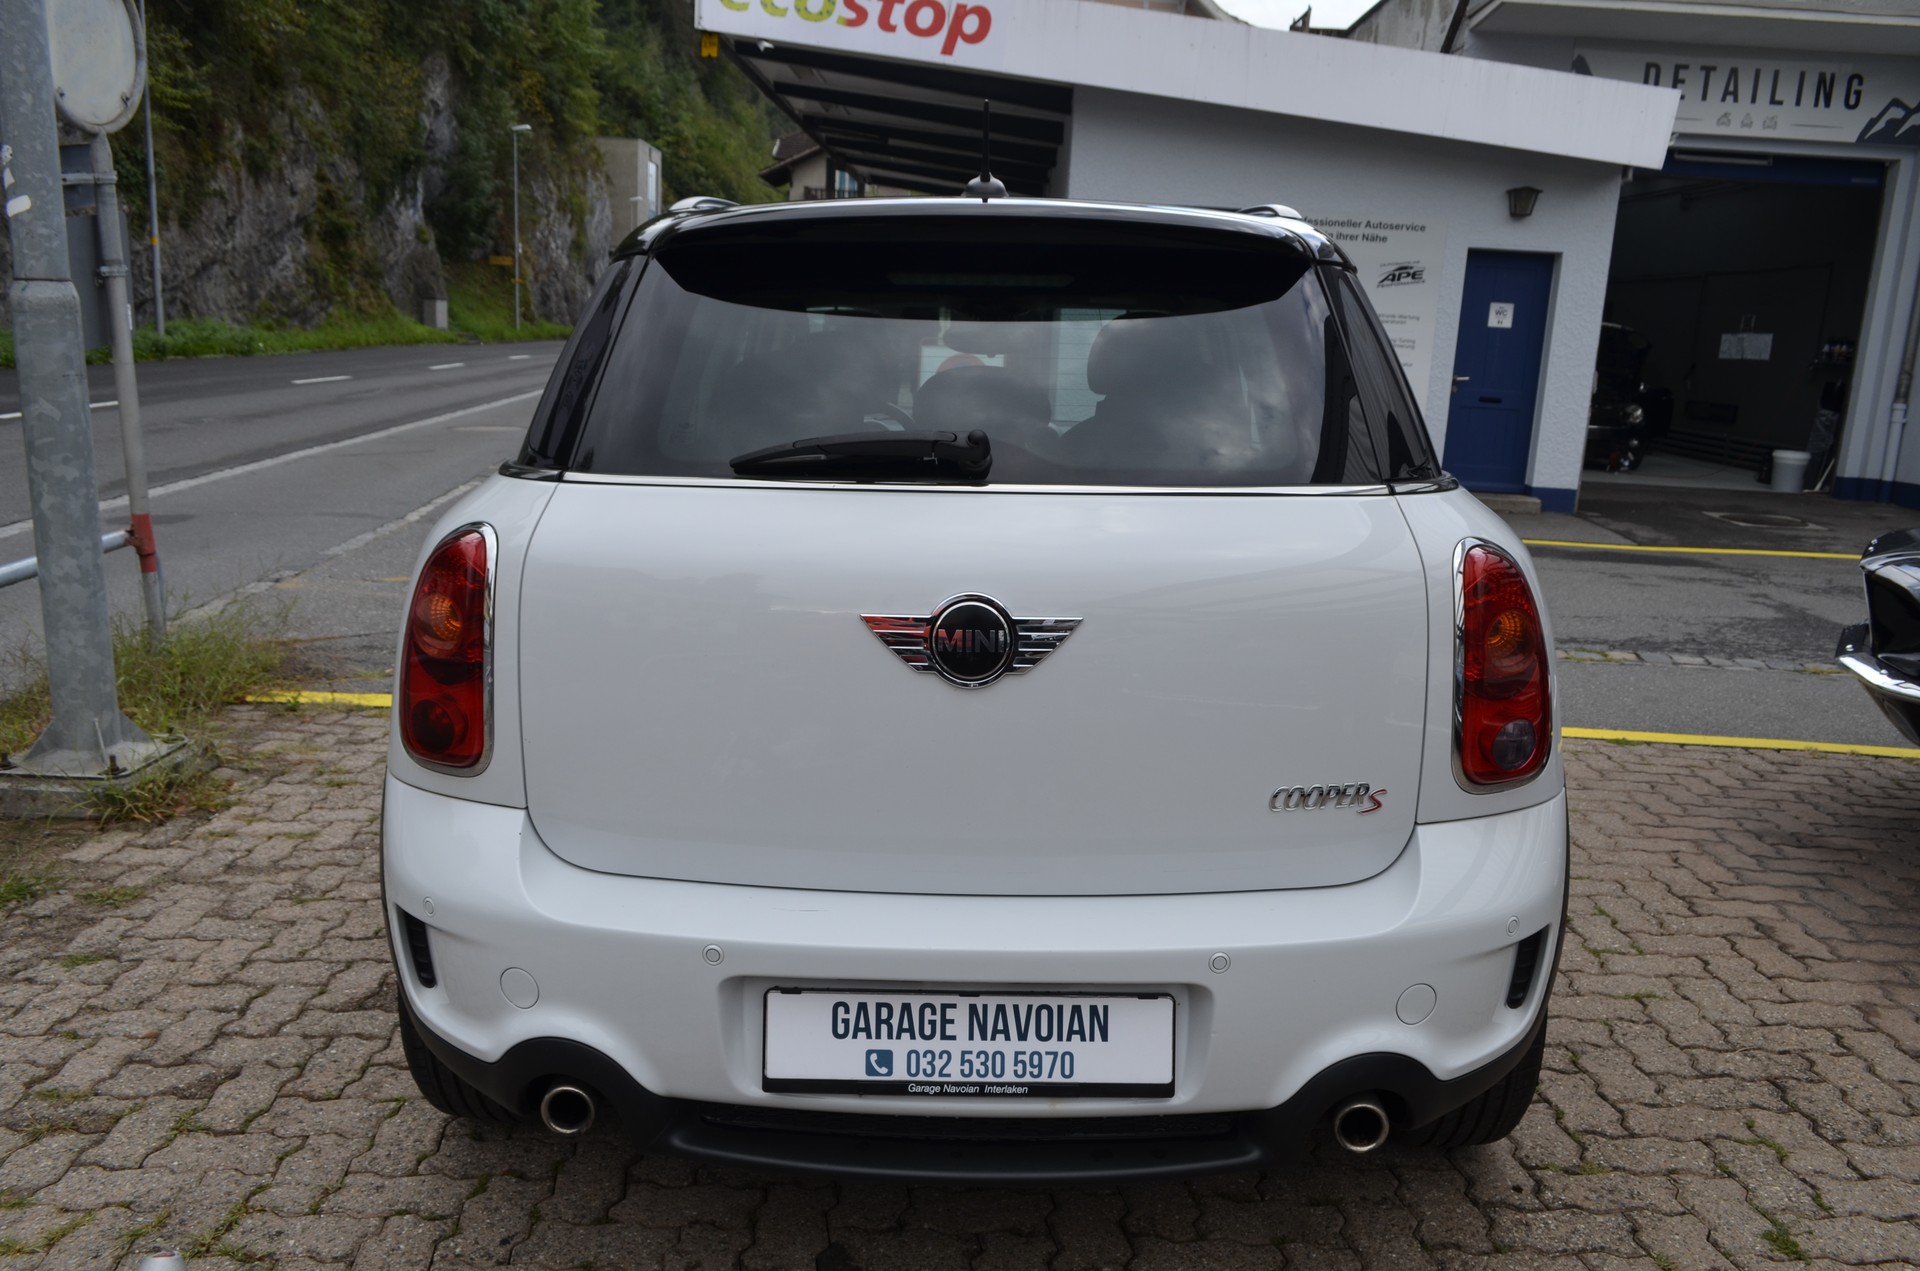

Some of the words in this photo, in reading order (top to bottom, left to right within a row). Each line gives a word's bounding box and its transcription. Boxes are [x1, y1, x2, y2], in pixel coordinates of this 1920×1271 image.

[1642, 61, 1865, 110] DETAILING
[1364, 220, 1426, 232] Autoservice
[1336, 233, 1359, 242] ihrer
[1361, 234, 1388, 243] Nähe
[1378, 270, 1425, 284] APE
[938, 629, 1005, 653] MINI
[831, 1000, 958, 1041] GARAGE
[967, 1003, 1110, 1043] NAVOIAN
[905, 1049, 952, 1078] 032
[959, 1050, 1006, 1079] 530
[1012, 1050, 1075, 1079] 5970
[907, 1083, 941, 1095] Garage
[942, 1084, 980, 1094] Navoian
[984, 1084, 1029, 1094] Interlaken
